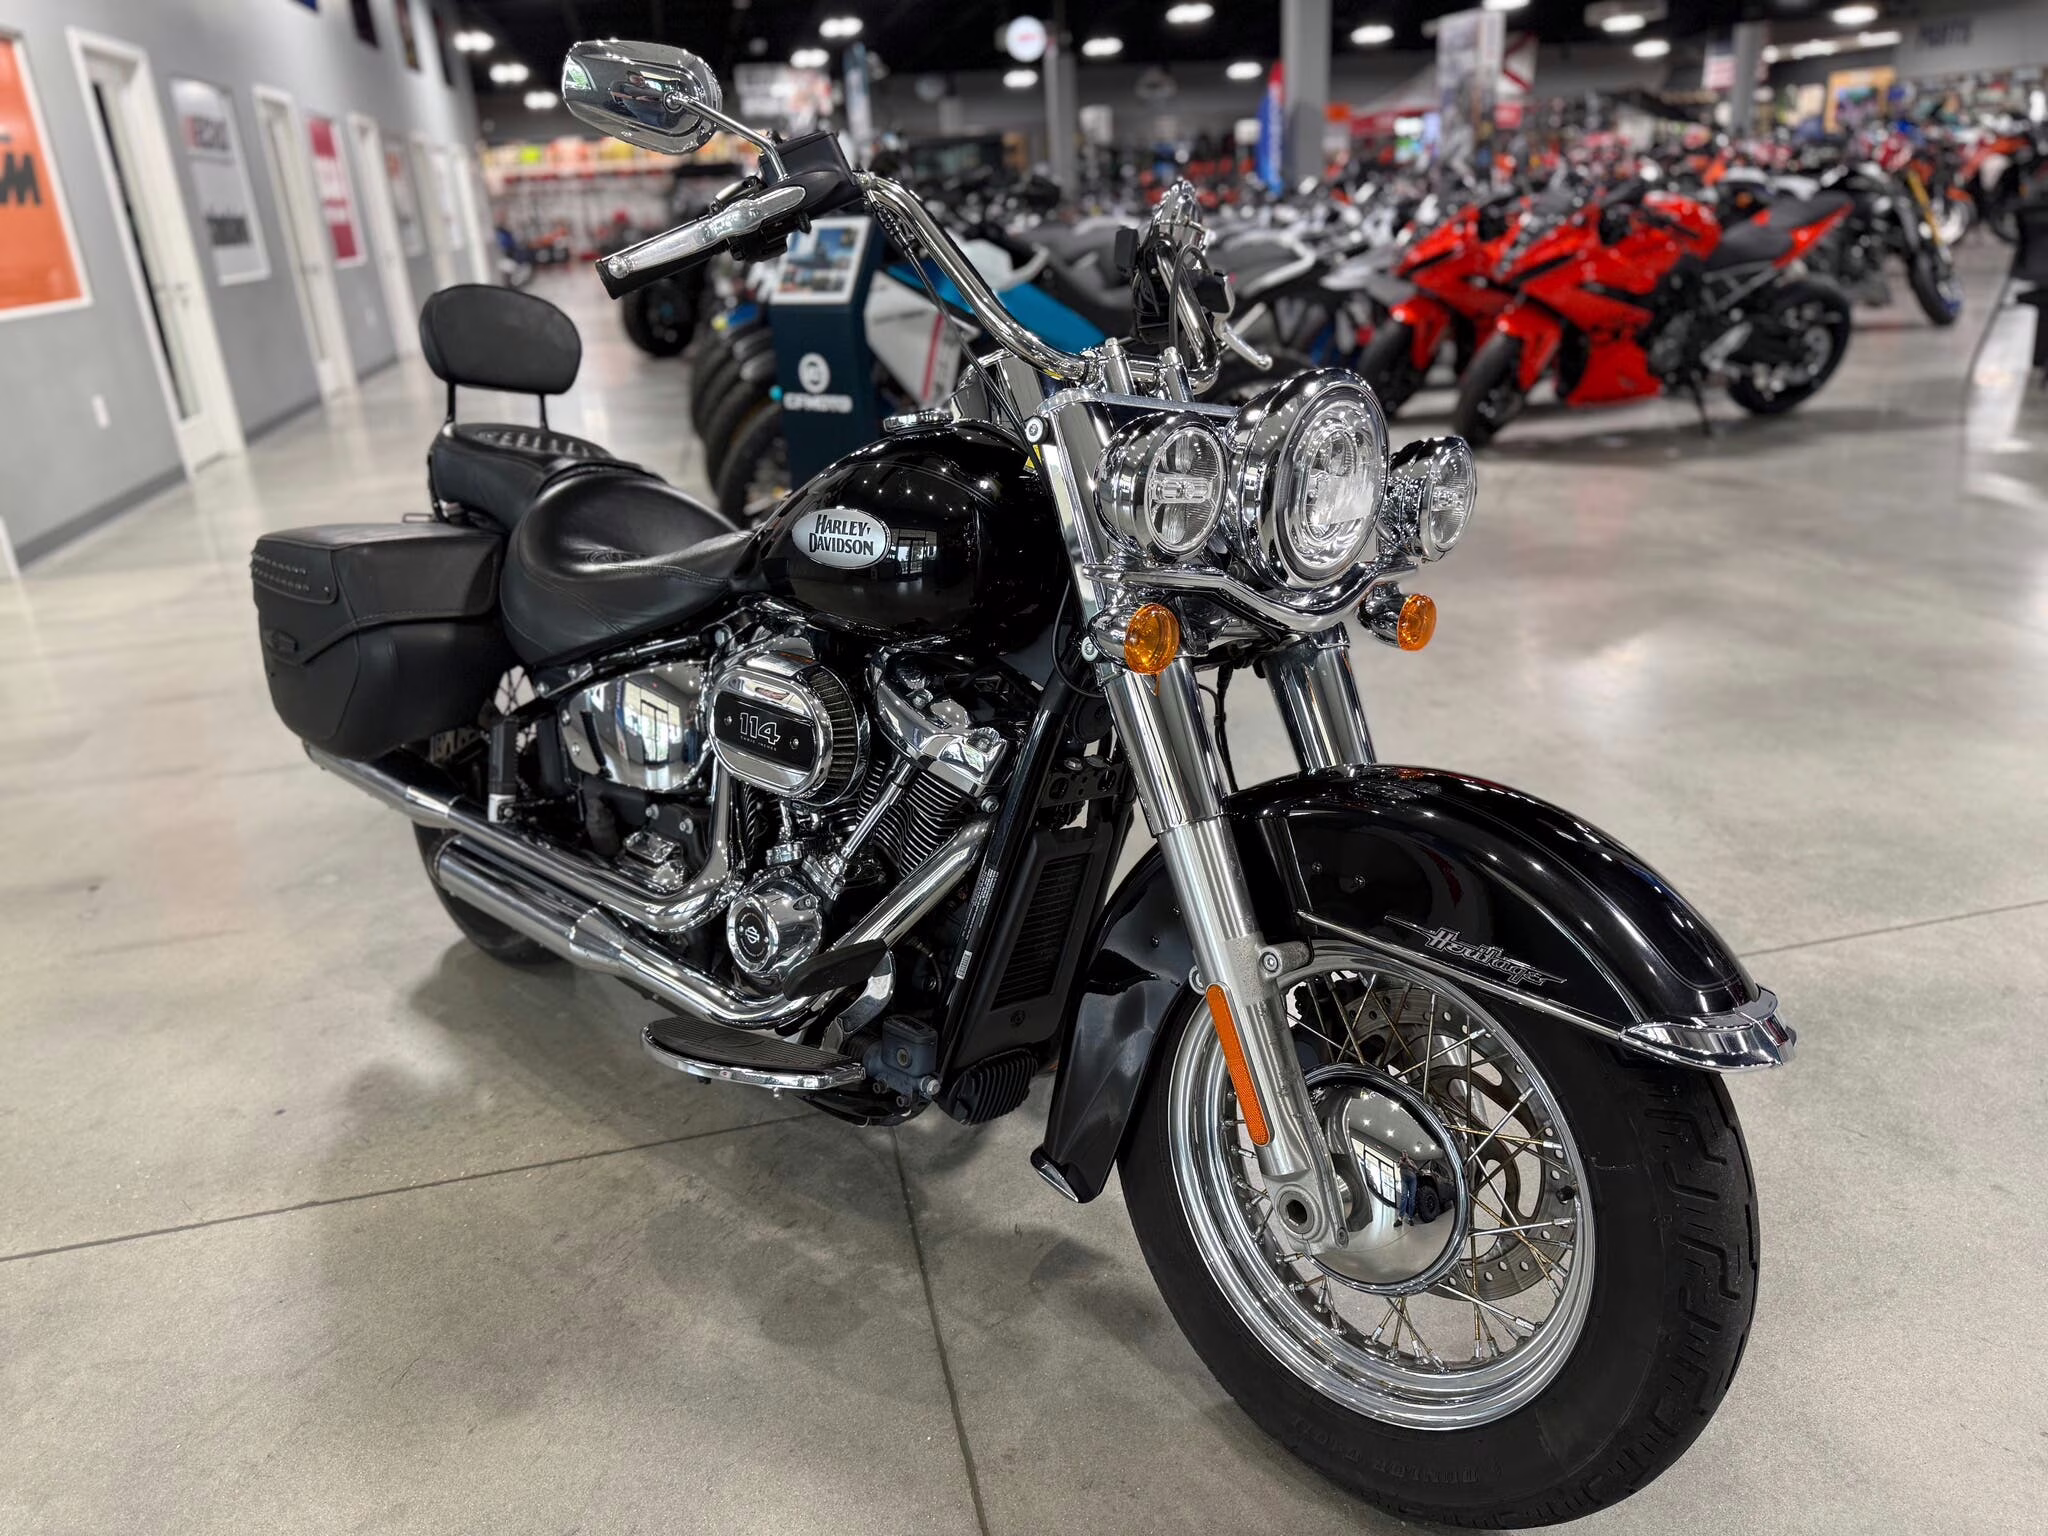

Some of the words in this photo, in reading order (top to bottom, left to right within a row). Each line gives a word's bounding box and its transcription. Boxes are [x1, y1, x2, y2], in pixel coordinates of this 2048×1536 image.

[809, 532, 874, 556] DAVIDSON
[739, 712, 781, 745] 114
[1426, 926, 1550, 986] Heritage
